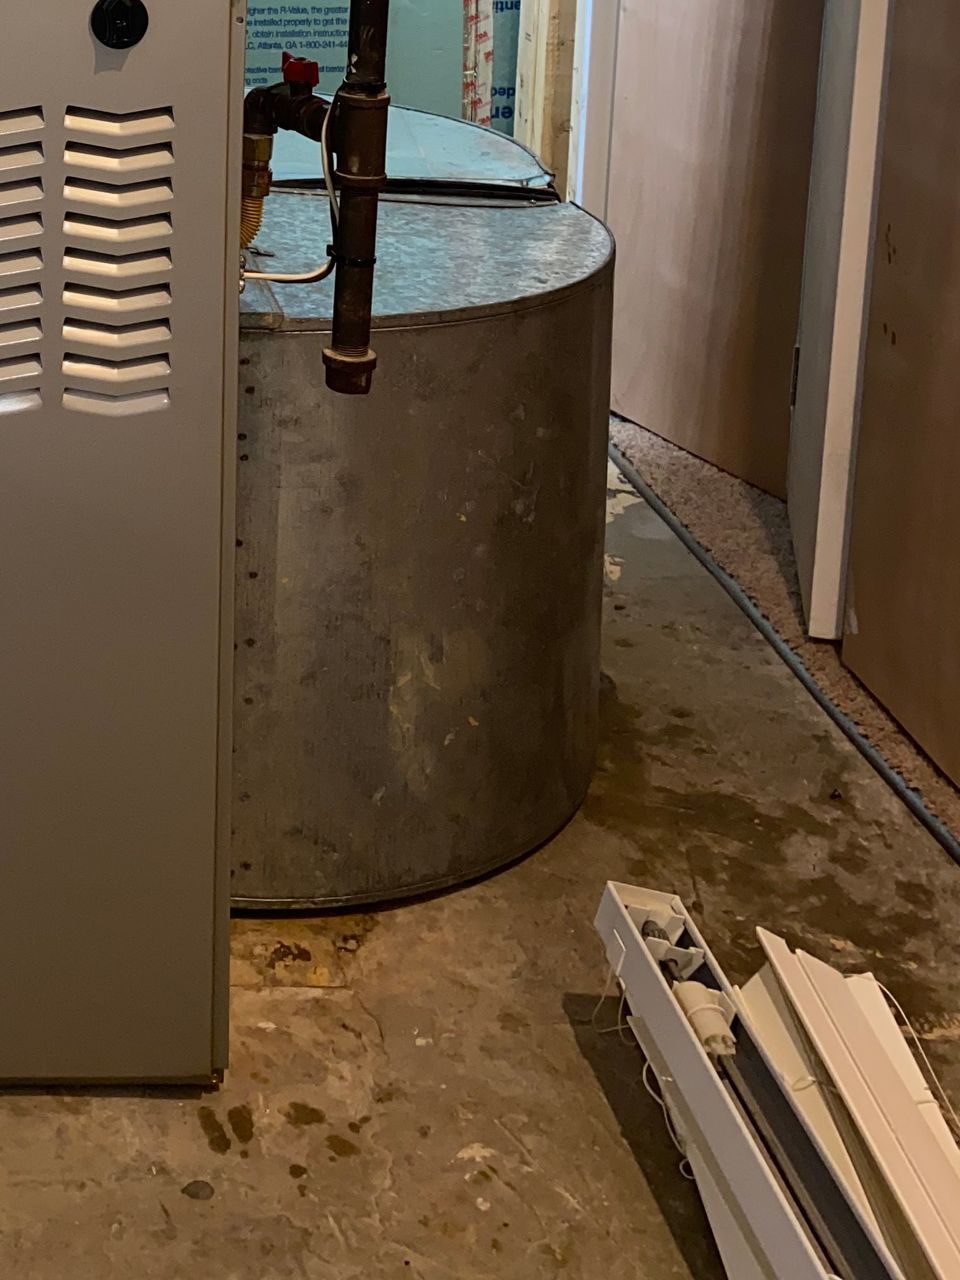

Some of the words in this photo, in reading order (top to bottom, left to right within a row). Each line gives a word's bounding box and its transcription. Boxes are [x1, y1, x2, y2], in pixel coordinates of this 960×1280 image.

[311, 6, 322, 14] the
[284, 19, 311, 28] properly
[322, 19, 334, 27] get
[252, 30, 274, 38] obtain
[275, 30, 312, 38] installation
[257, 42, 283, 50] Atlanta,
